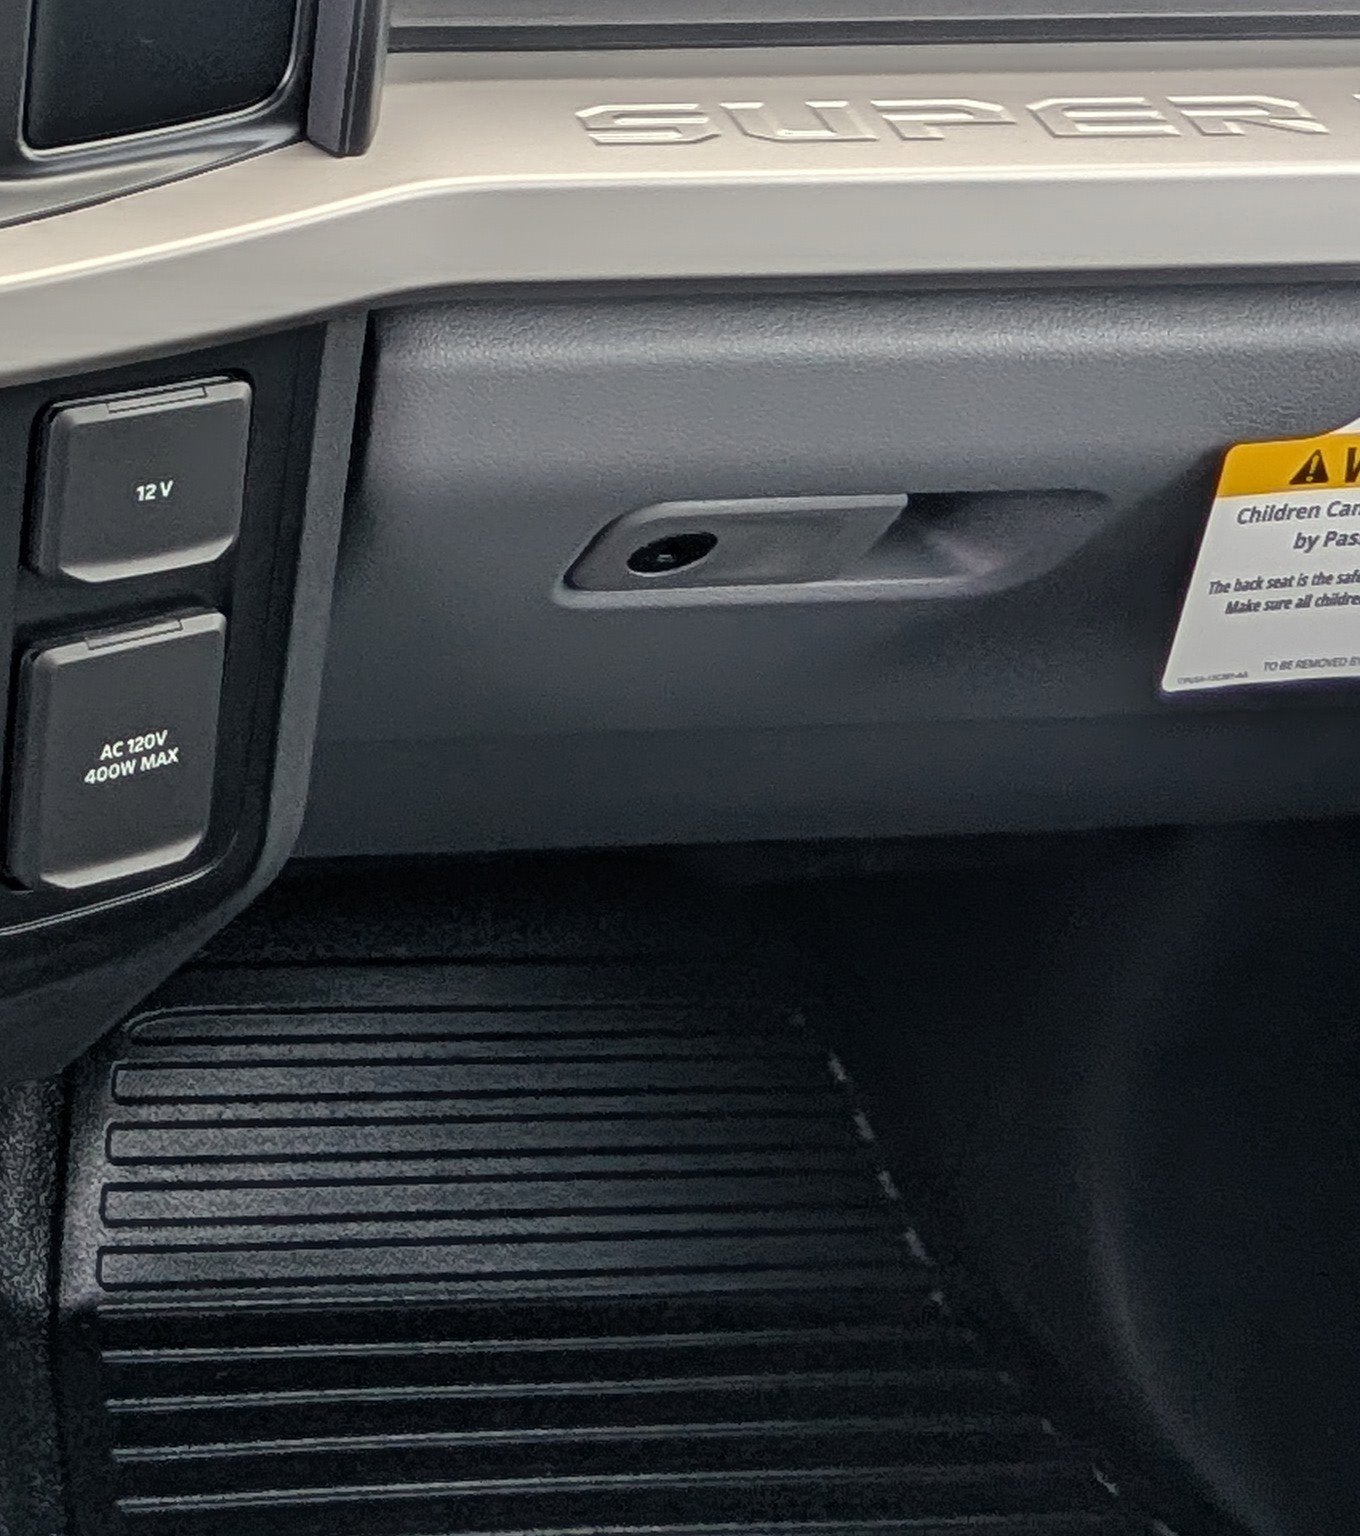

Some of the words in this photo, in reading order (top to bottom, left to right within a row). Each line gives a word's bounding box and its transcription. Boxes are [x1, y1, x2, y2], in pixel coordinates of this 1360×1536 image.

[574, 95, 1330, 145] SUPER
[136, 483, 156, 502] 12
[159, 480, 174, 498] V
[1236, 501, 1321, 526] Children
[1293, 531, 1321, 554] by
[1209, 580, 1231, 595] The
[1233, 575, 1264, 592] back
[1266, 575, 1295, 590] seat
[1297, 573, 1309, 587] is
[1311, 571, 1334, 586] the
[1225, 598, 1261, 614] Make
[1263, 598, 1293, 612] sure
[1295, 594, 1314, 608] all
[1264, 661, 1278, 672] TO
[1295, 657, 1348, 670] REMOVED
[99, 739, 125, 761] AC
[127, 729, 169, 755] 120V
[84, 759, 137, 785] 400W
[140, 747, 180, 772] MAX
